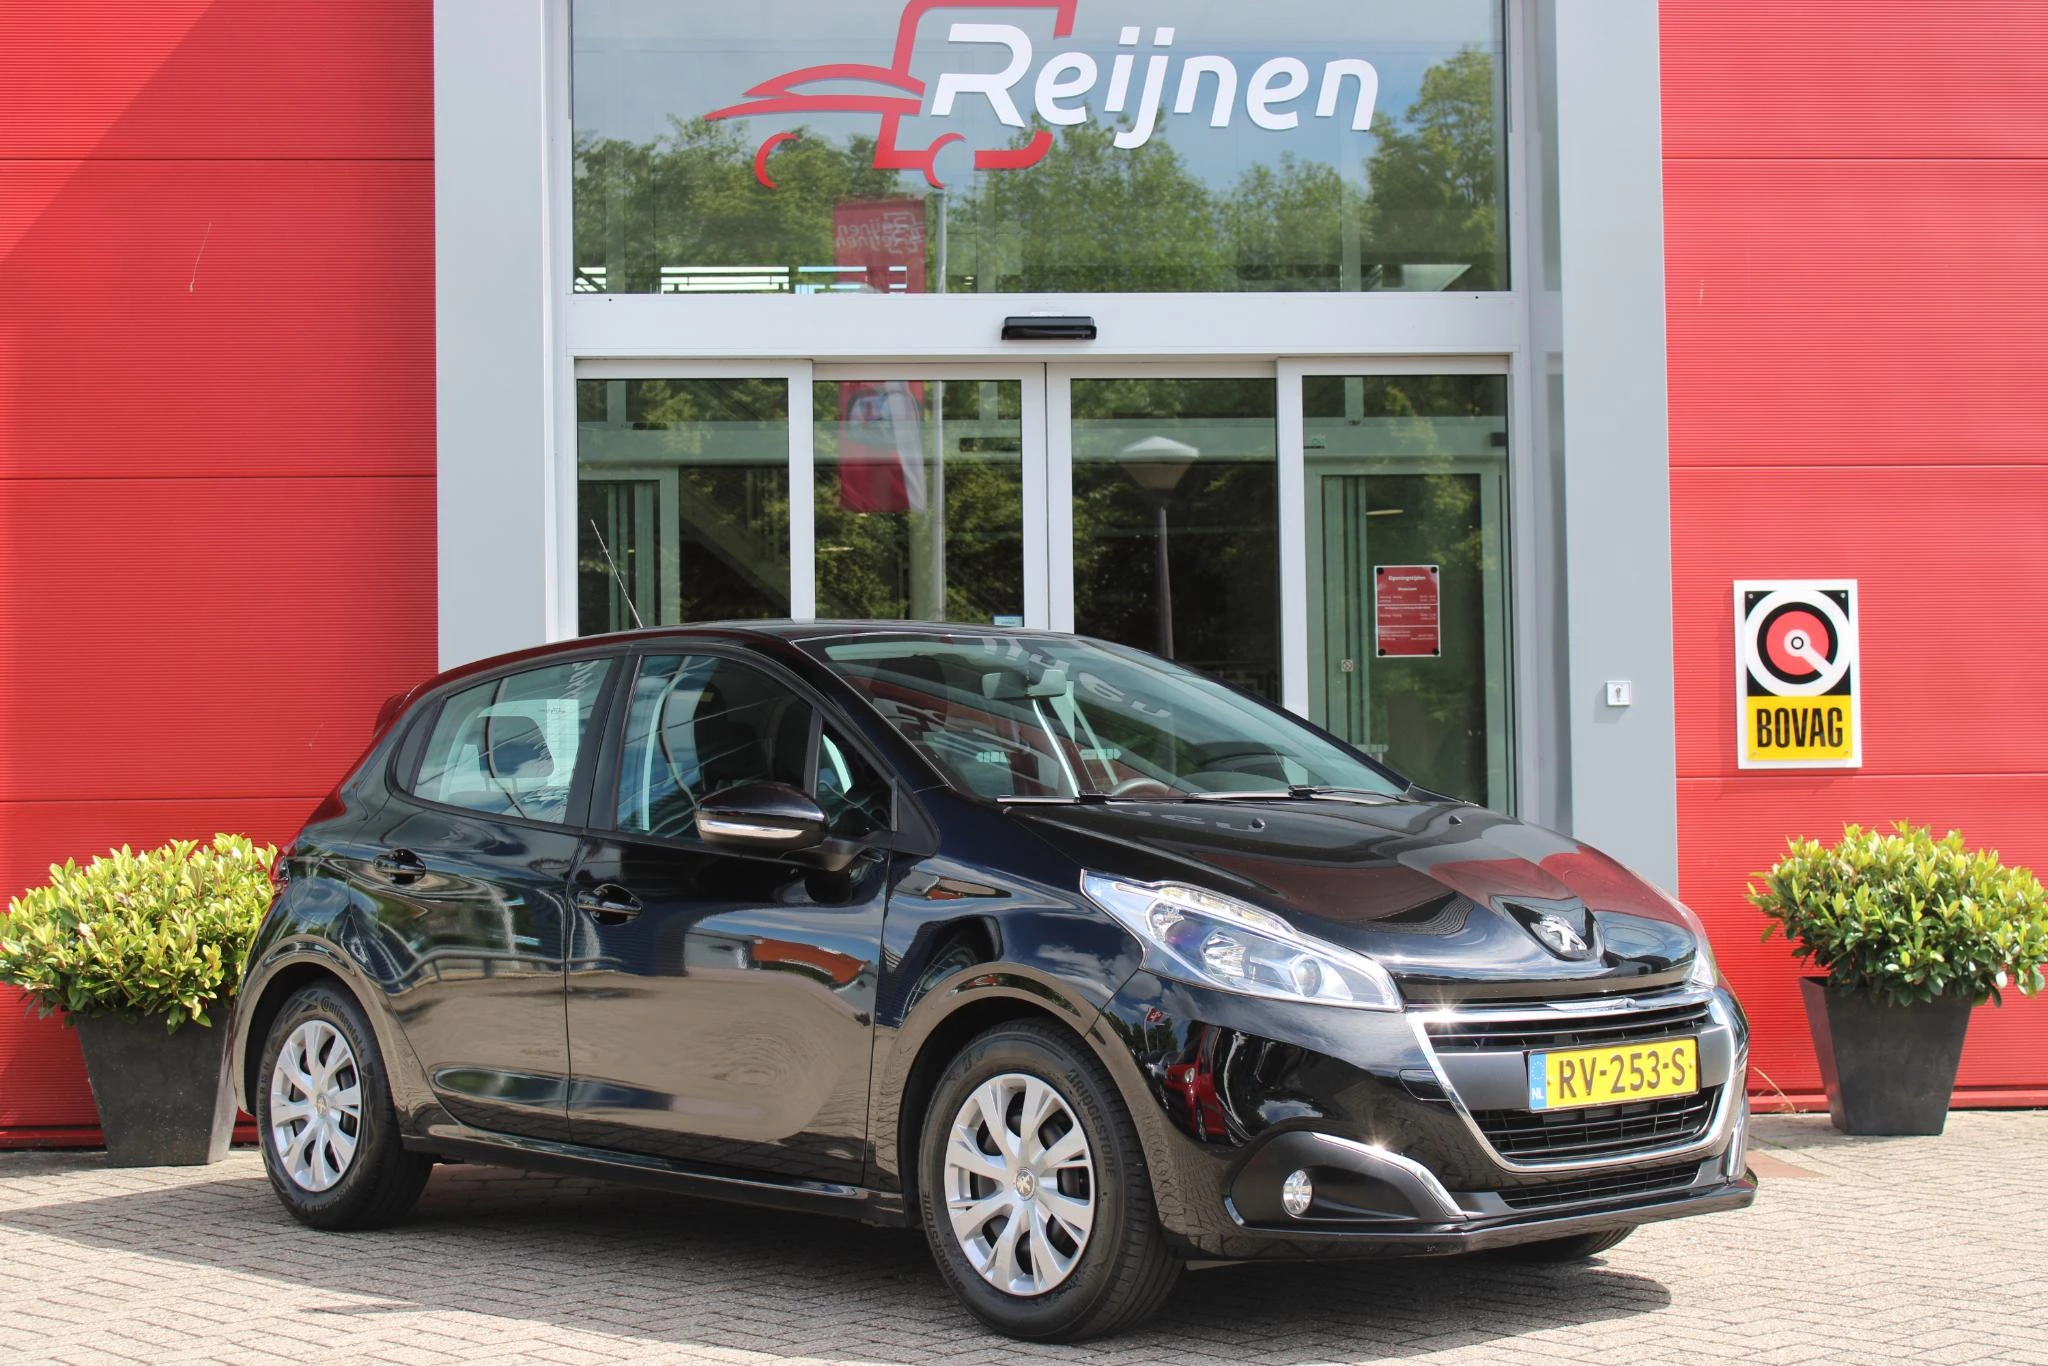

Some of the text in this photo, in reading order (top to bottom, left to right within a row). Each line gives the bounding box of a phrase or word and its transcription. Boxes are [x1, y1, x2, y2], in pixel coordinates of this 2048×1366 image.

[930, 23, 1379, 149] Reijnen
[1756, 707, 1843, 748] BOVAG
[320, 996, 363, 1048] Continental
[1531, 1087, 1545, 1100] NL
[1559, 1047, 1686, 1099] RV-253-S
[1064, 1068, 1116, 1177] BRIDGESTONE
